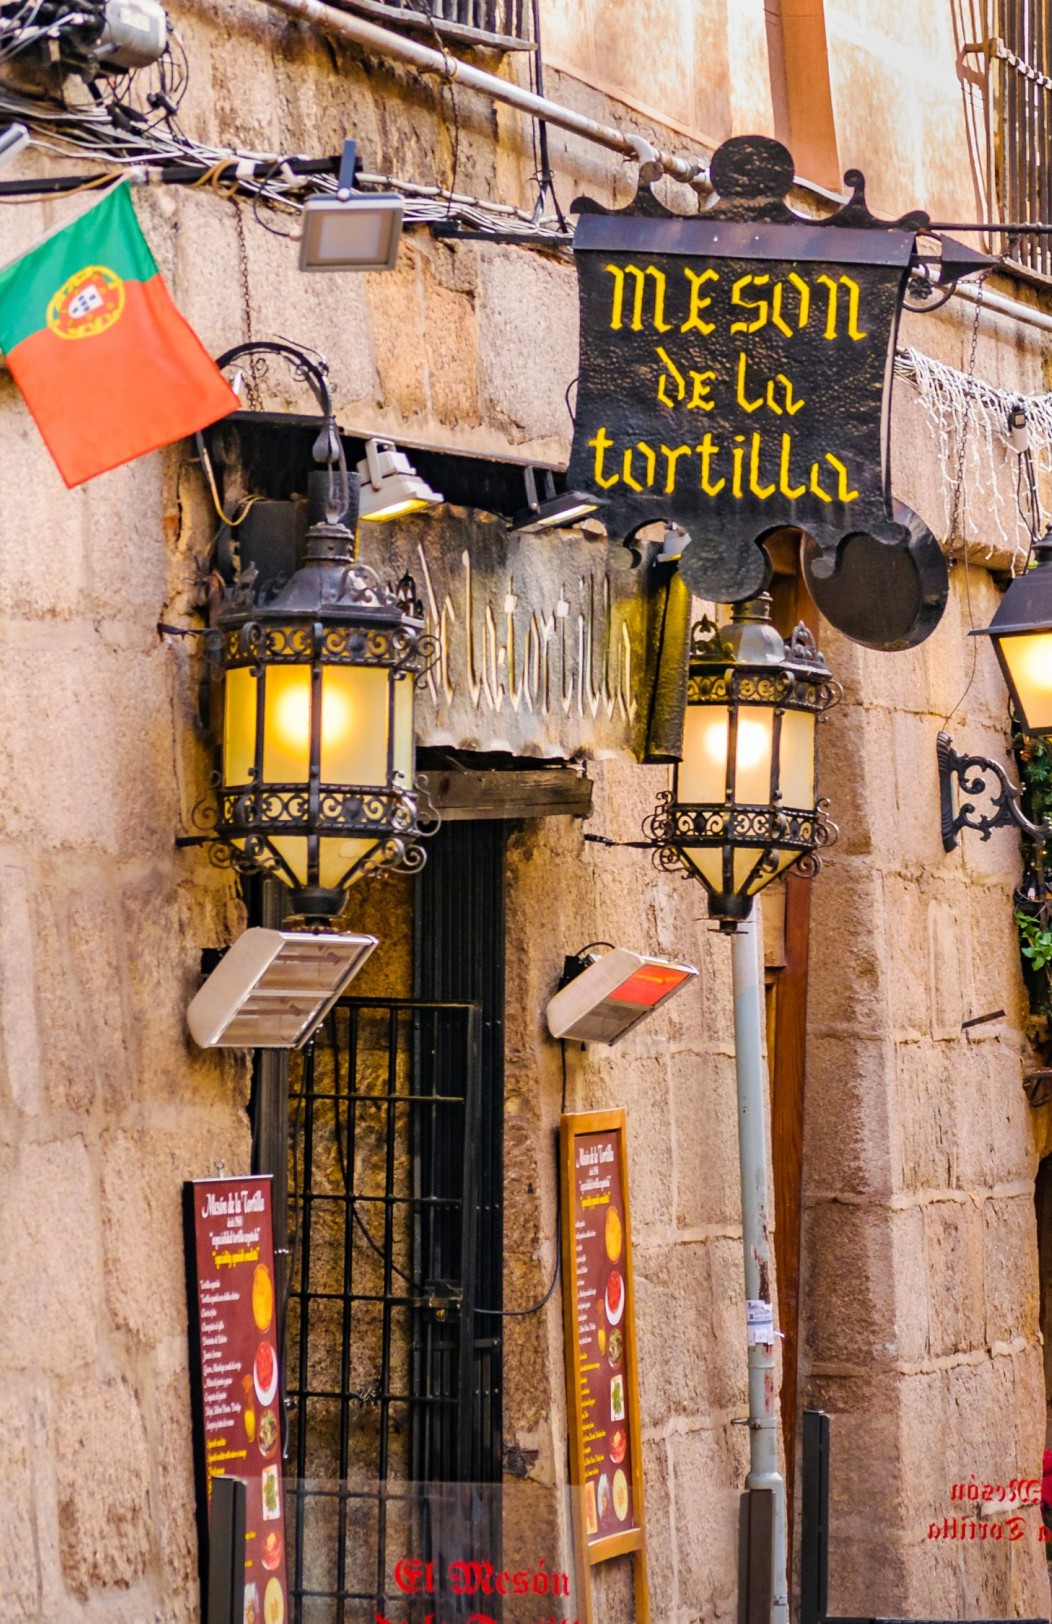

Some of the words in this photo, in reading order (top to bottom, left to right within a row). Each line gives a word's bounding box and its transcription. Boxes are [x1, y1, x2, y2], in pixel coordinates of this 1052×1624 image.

[736, 351, 806, 416] la
[587, 426, 860, 503] tortilla
[393, 1557, 436, 1594] El
[447, 1558, 571, 1597] Mesón
